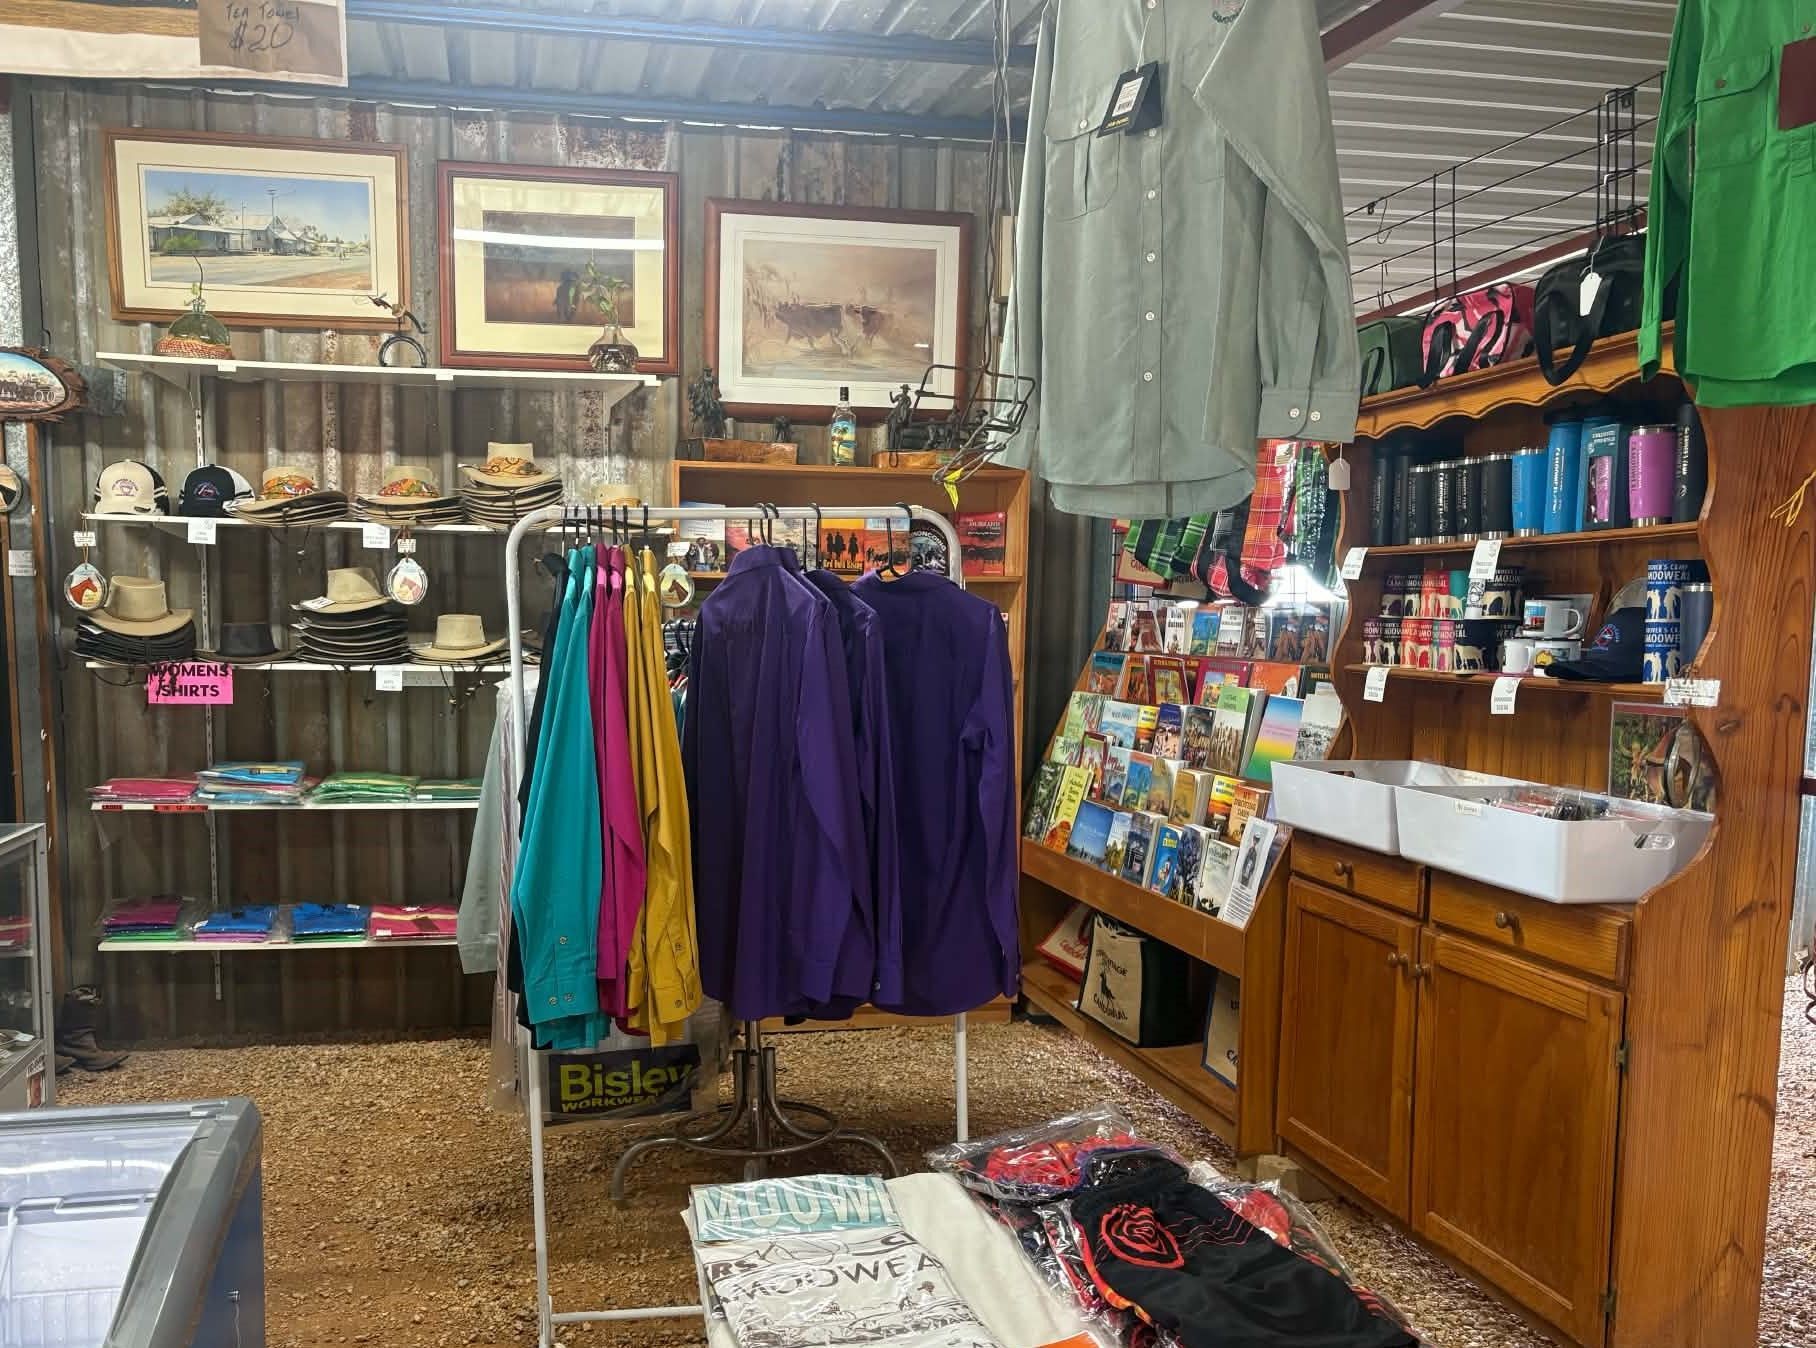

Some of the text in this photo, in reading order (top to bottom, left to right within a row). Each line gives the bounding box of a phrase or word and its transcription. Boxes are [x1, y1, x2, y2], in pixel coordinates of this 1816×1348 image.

[229, 21, 294, 53] $20
[161, 684, 220, 697] SHIRTS
[561, 1096, 658, 1113] WORKWEA
[704, 1260, 758, 1280] RS
